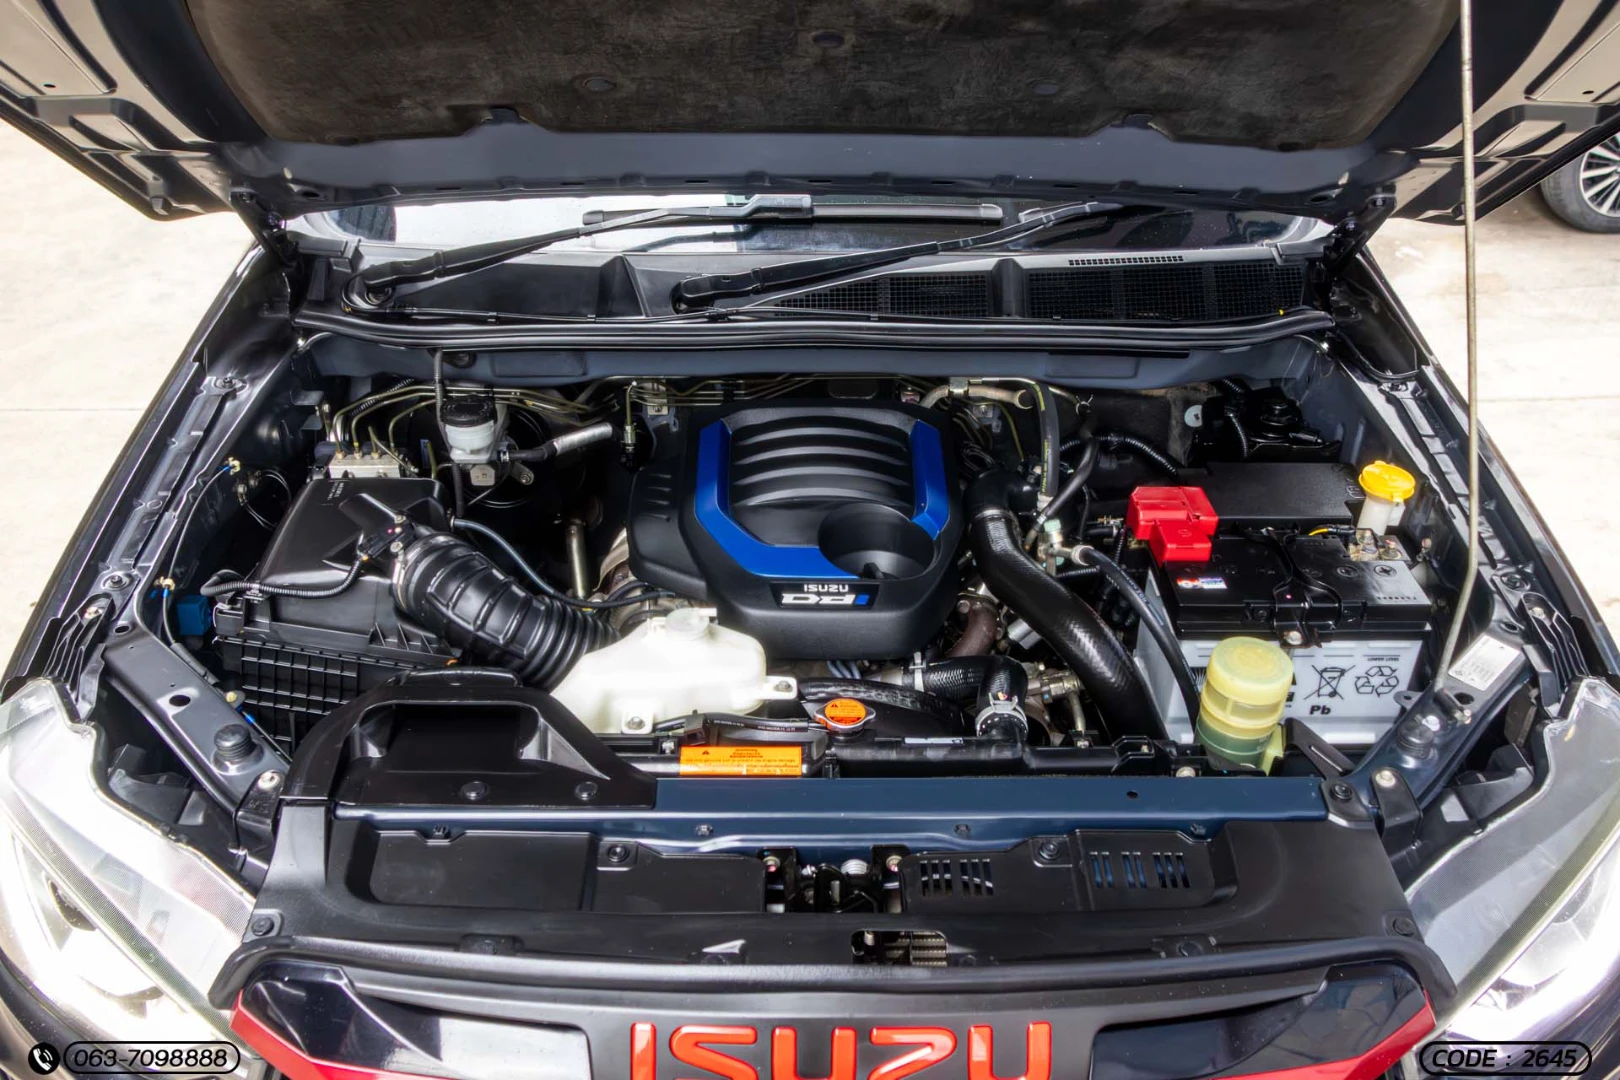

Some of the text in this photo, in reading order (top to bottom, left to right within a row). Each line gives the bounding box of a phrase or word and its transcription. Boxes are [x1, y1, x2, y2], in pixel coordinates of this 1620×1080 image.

[803, 584, 849, 592] ISUZU
[1309, 705, 1332, 715] Pb
[630, 1021, 1052, 1080] ISUZU
